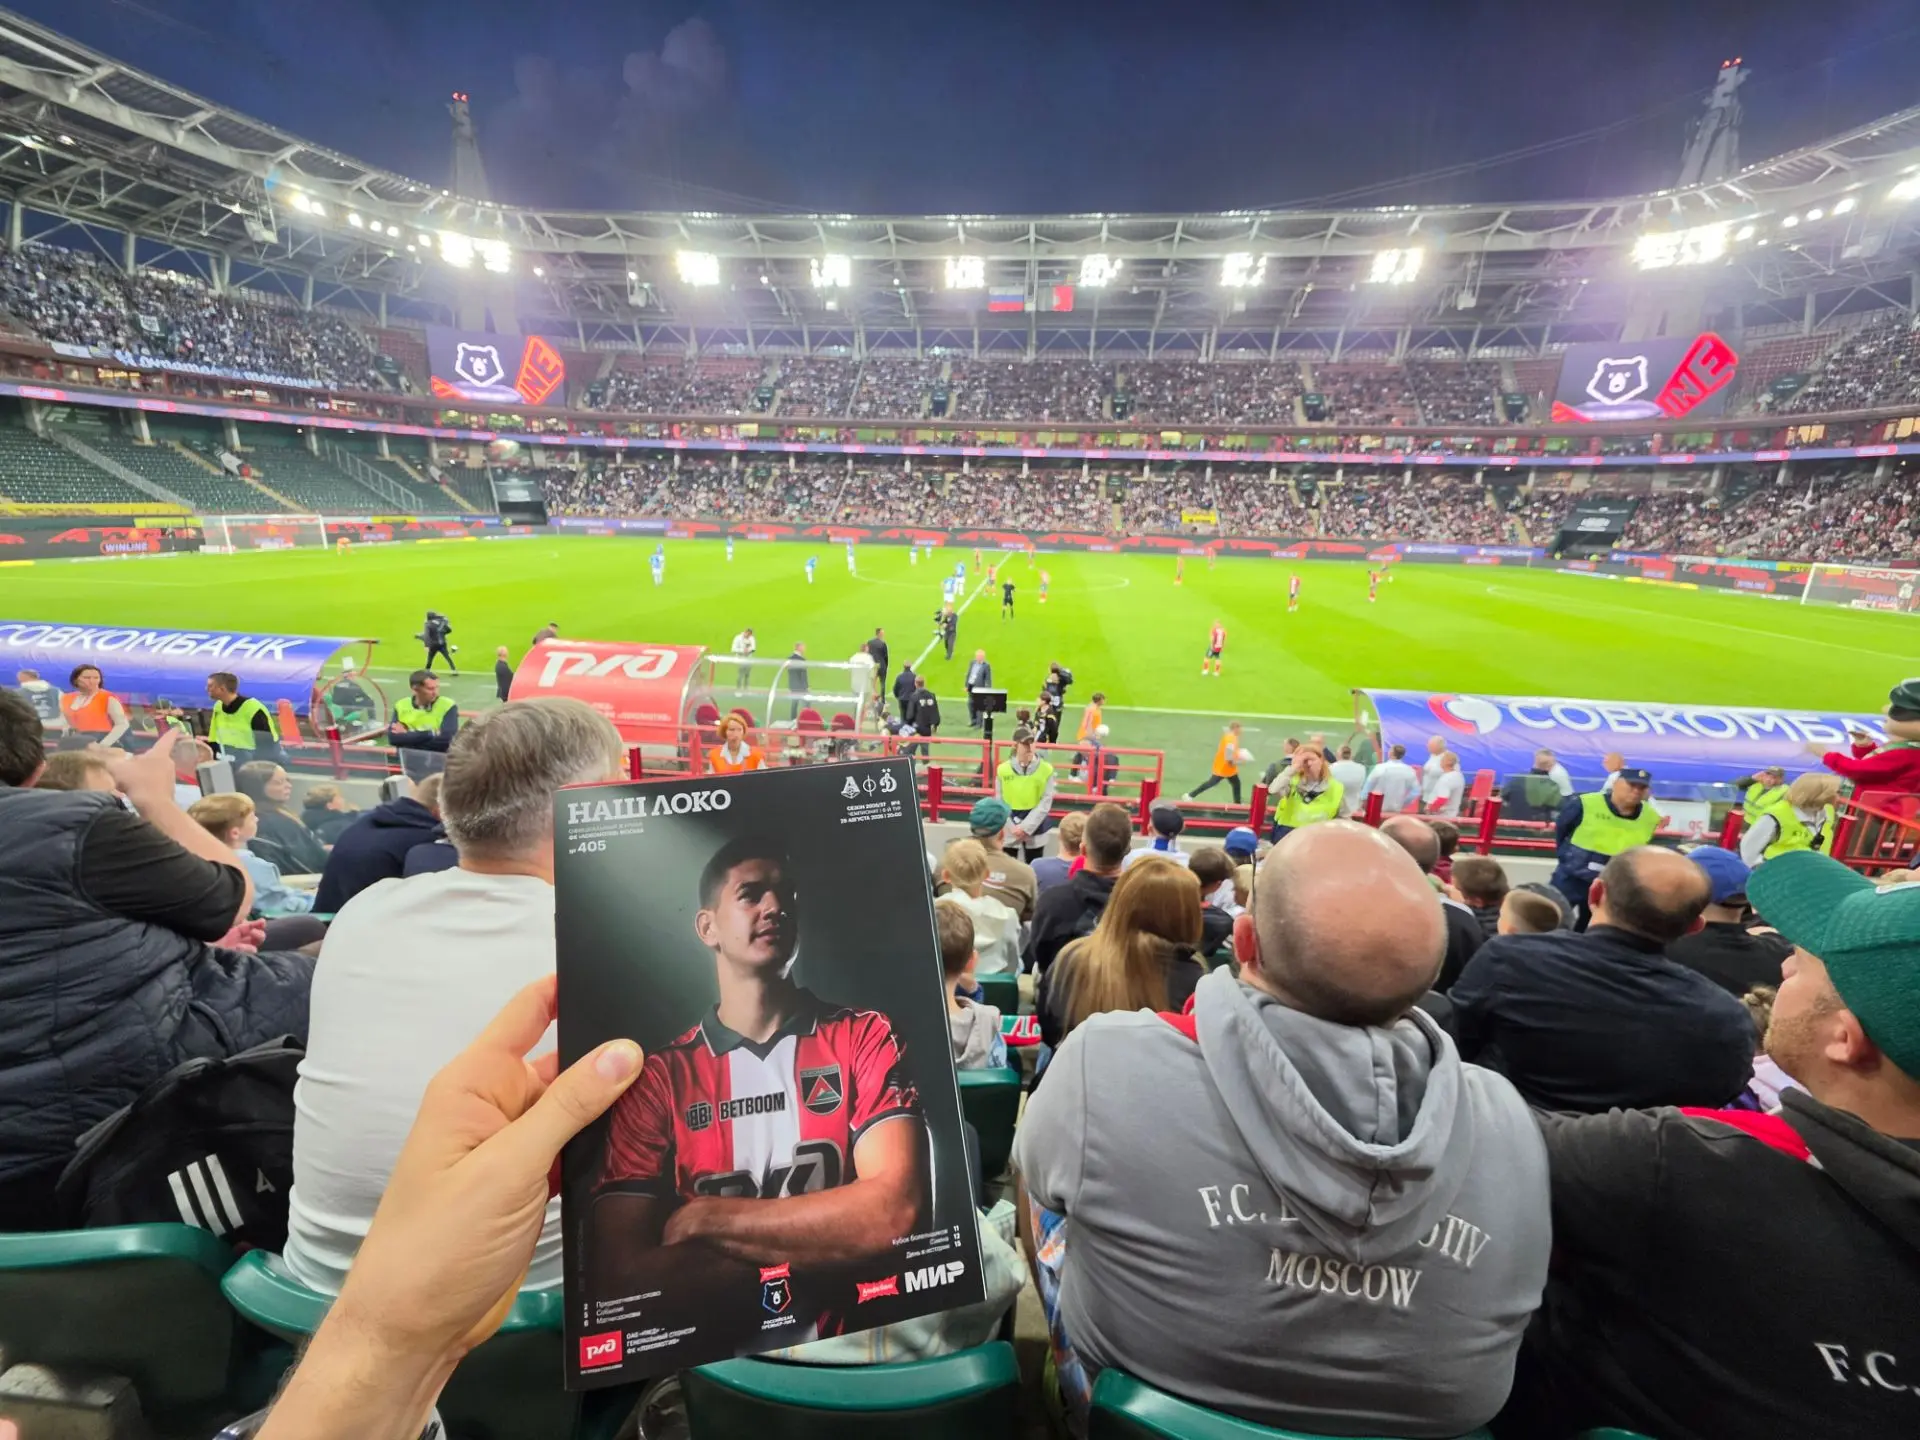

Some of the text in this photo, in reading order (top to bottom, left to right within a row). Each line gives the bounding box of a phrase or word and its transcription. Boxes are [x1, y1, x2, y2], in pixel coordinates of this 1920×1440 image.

[104, 541, 148, 552] WINLINE
[1506, 702, 1887, 744] СОВКОМБА
[567, 789, 732, 825] НАШ ЛОКО
[720, 1091, 786, 1121] BETBOOM
[1198, 1183, 1267, 1228] F.C.
[904, 1260, 965, 1293] МИР
[1266, 1247, 1423, 1308] MOSCOW
